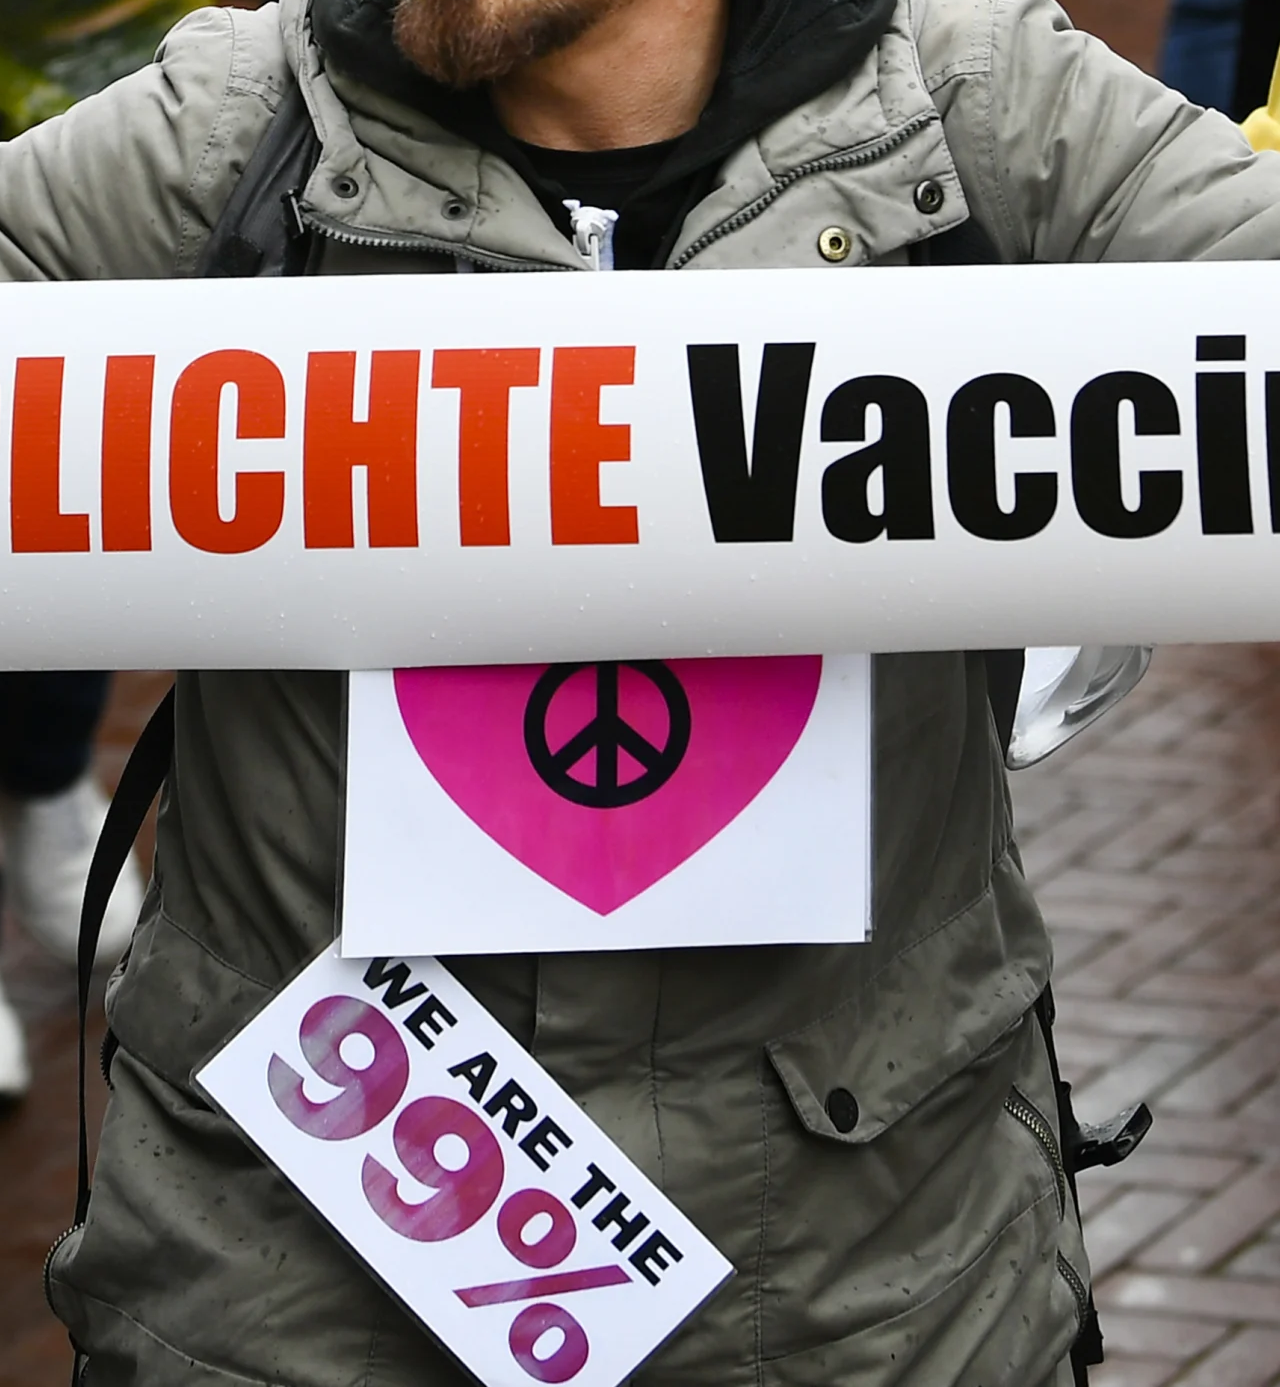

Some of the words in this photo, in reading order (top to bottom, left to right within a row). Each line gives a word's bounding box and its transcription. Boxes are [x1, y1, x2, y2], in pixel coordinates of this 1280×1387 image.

[266, 993, 633, 1385] 99%
[361, 956, 458, 1050] WE
[447, 1052, 573, 1172] ARE
[569, 1162, 684, 1288] THE
